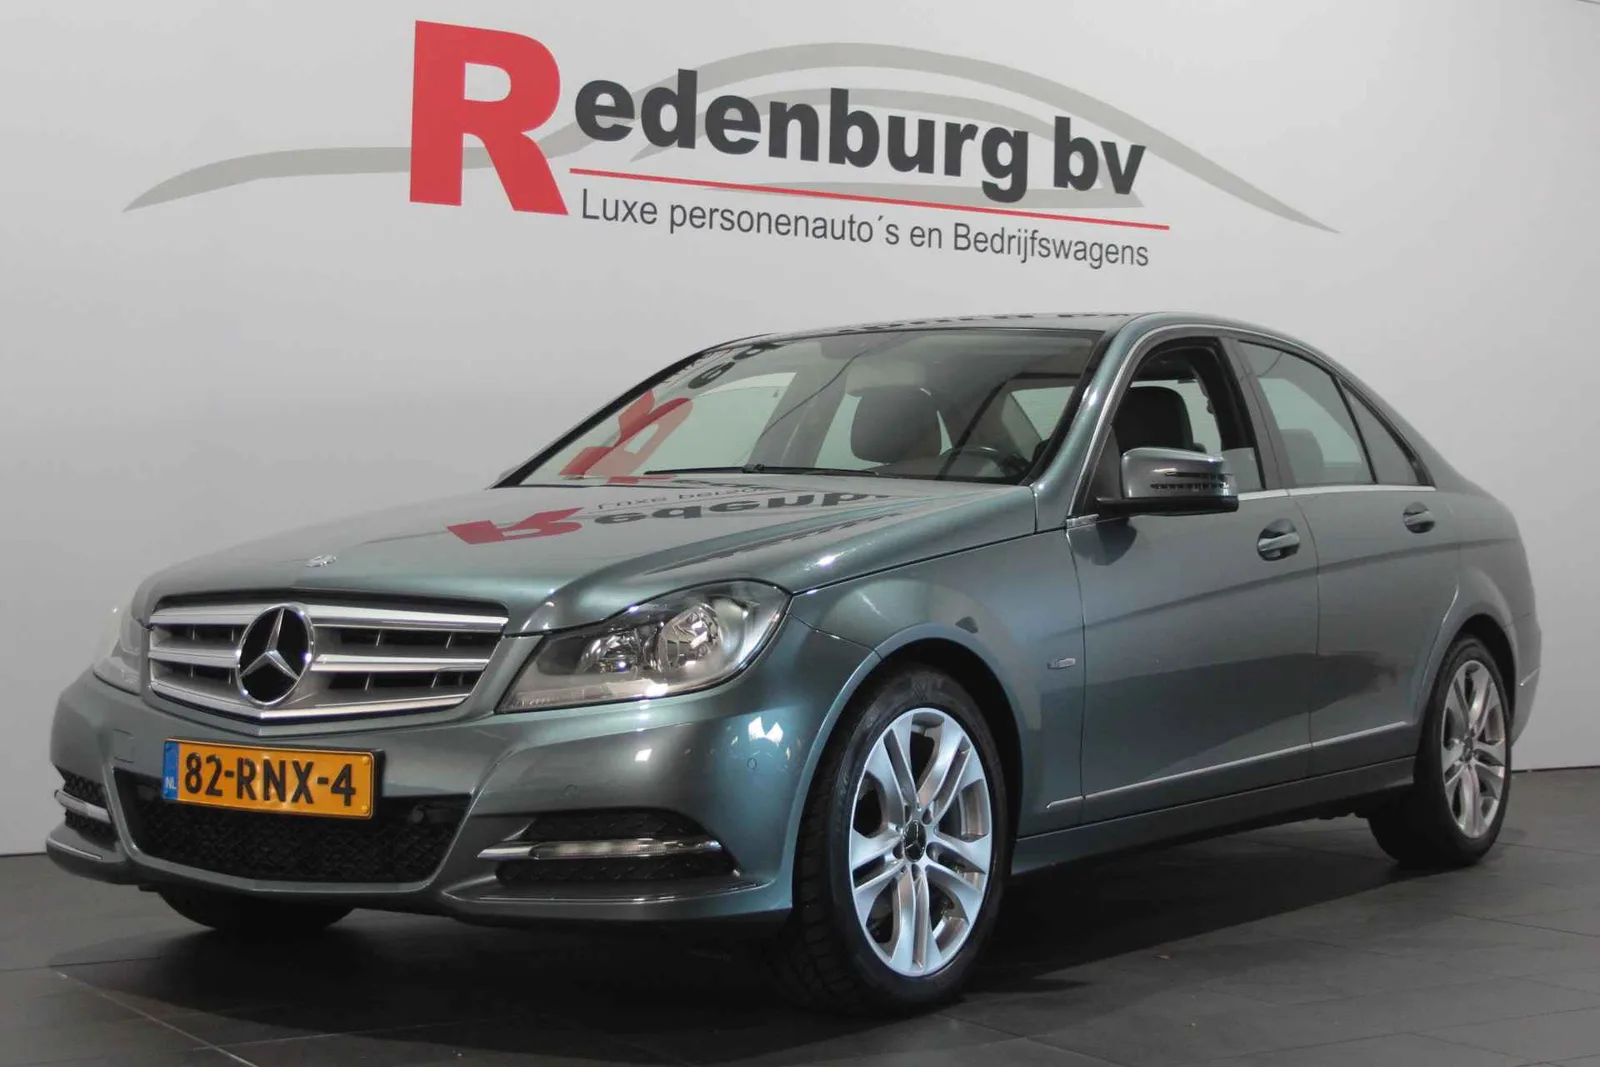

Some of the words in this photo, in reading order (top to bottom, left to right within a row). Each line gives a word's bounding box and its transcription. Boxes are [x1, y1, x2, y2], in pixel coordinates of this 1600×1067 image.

[409, 20, 1029, 215] Redenburg
[1053, 115, 1147, 195] bv
[582, 188, 658, 225] Luxe
[910, 226, 942, 249] en
[954, 222, 1149, 270] Bedrijfswagens
[165, 778, 177, 791] NL
[184, 751, 357, 807] 82-RNX-4
